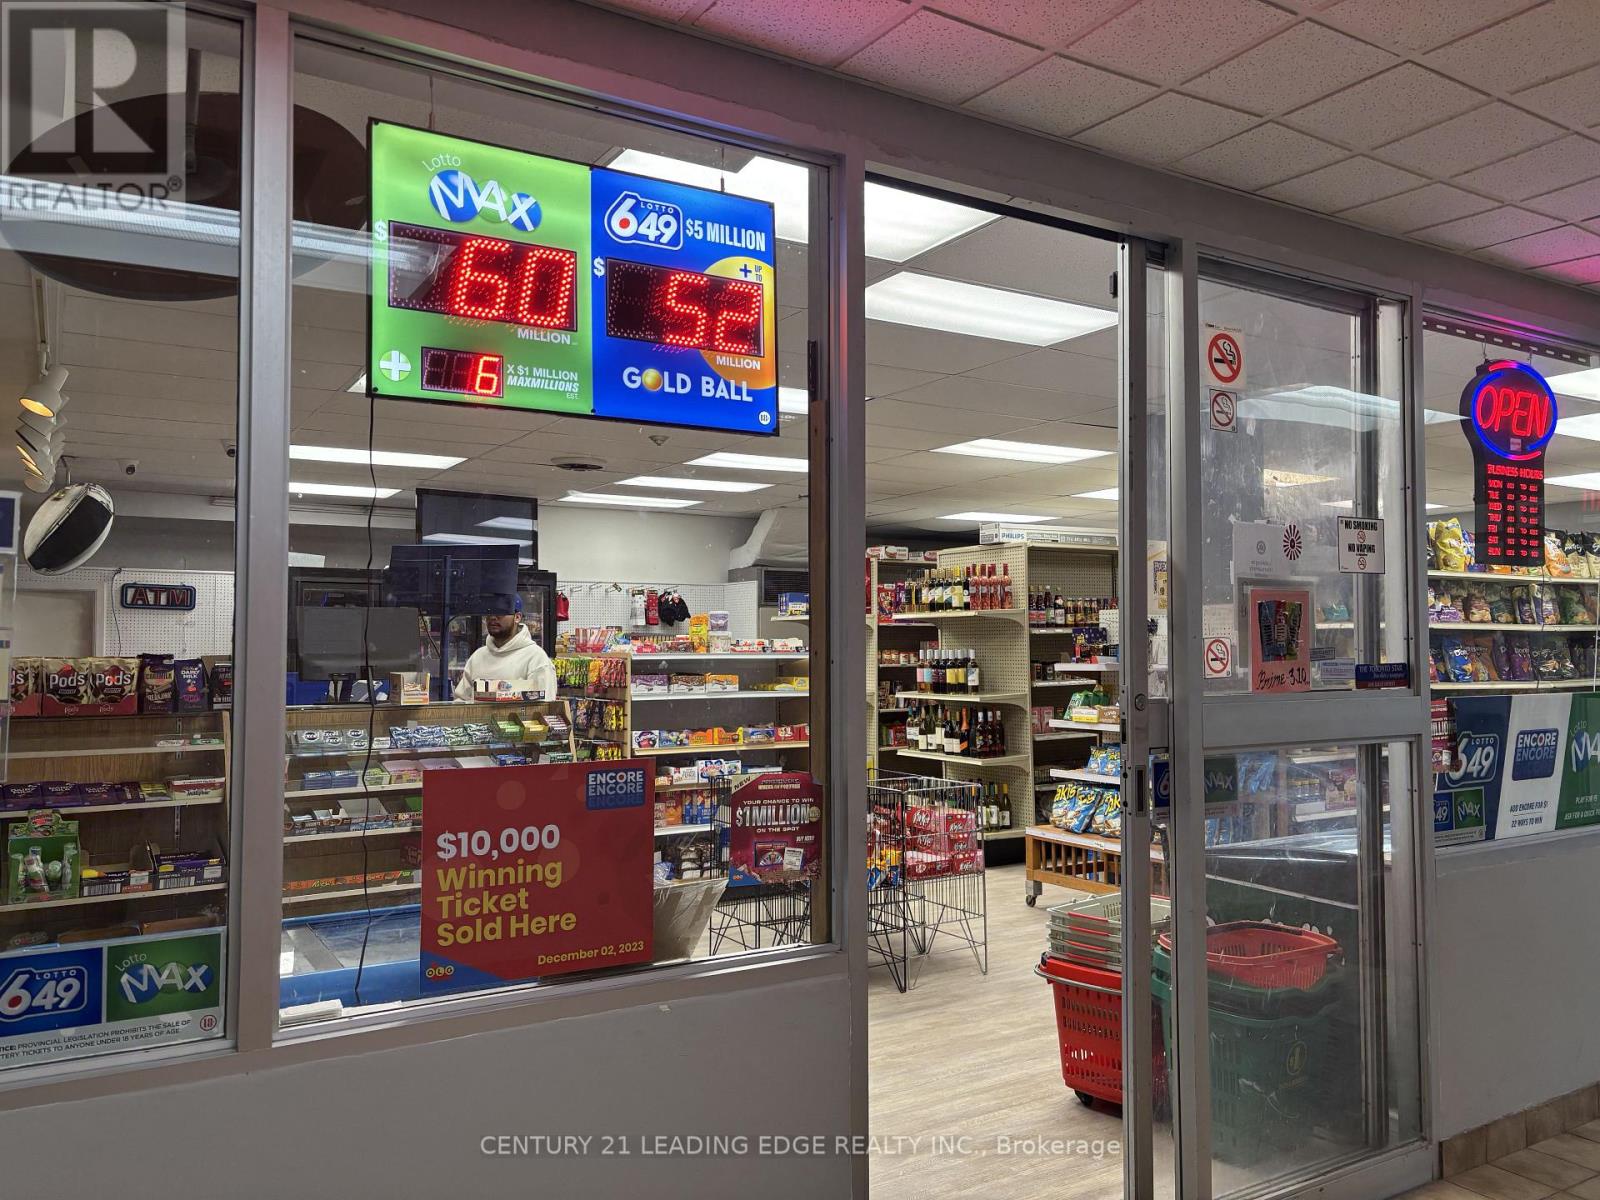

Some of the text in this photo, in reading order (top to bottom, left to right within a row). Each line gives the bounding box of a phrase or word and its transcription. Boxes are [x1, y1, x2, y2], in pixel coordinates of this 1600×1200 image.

[422, 153, 462, 172] Lotto
[430, 171, 537, 232] MAX
[640, 202, 675, 214] LOTTO
[374, 220, 387, 243] $
[686, 217, 766, 252] $5 MILLION
[593, 256, 606, 278] $
[454, 238, 577, 326] 60
[666, 272, 762, 353] 52
[517, 328, 571, 345] MILLION
[517, 364, 530, 376] $1
[532, 366, 578, 381] MILLION
[716, 356, 761, 370] MILLION
[474, 355, 500, 394] 6
[507, 375, 580, 393] MAXMILLIONS
[701, 376, 753, 402] BALL
[1476, 384, 1550, 439] OPEN
[1344, 519, 1378, 531] NO SMOKING
[1001, 531, 1025, 540] PHILIPS
[1347, 543, 1375, 554] NO VAPING
[130, 587, 191, 606] ATM
[49, 671, 85, 689] Pods
[95, 671, 132, 687] Pods
[1471, 737, 1495, 746] LOTTO
[1517, 732, 1557, 747] ENCORE
[1515, 746, 1555, 762] ENCORE
[588, 770, 644, 785] ENCORE
[588, 782, 644, 797] ENCORE
[436, 824, 560, 862] $10,000
[437, 858, 563, 893] Winning
[436, 887, 529, 919] Ticket
[436, 912, 577, 947] Sold Here
[115, 952, 147, 972] Lotto
[537, 940, 645, 965] December 02, 2023
[35, 969, 78, 981] LOTTO
[120, 962, 209, 1004] MAX
[18, 1038, 61, 1050] PROVINCIAL
[63, 1031, 109, 1043] LEGISLATION
[110, 1026, 147, 1036] PROHIBITS
[149, 1023, 161, 1031] THE
[163, 1020, 180, 1029] SALE
[22, 1046, 52, 1057] TICKETS
[53, 1045, 63, 1053] TO
[65, 1040, 96, 1050] ANYONE
[97, 1037, 120, 1046] UNDER
[131, 1032, 153, 1041] YEARS
